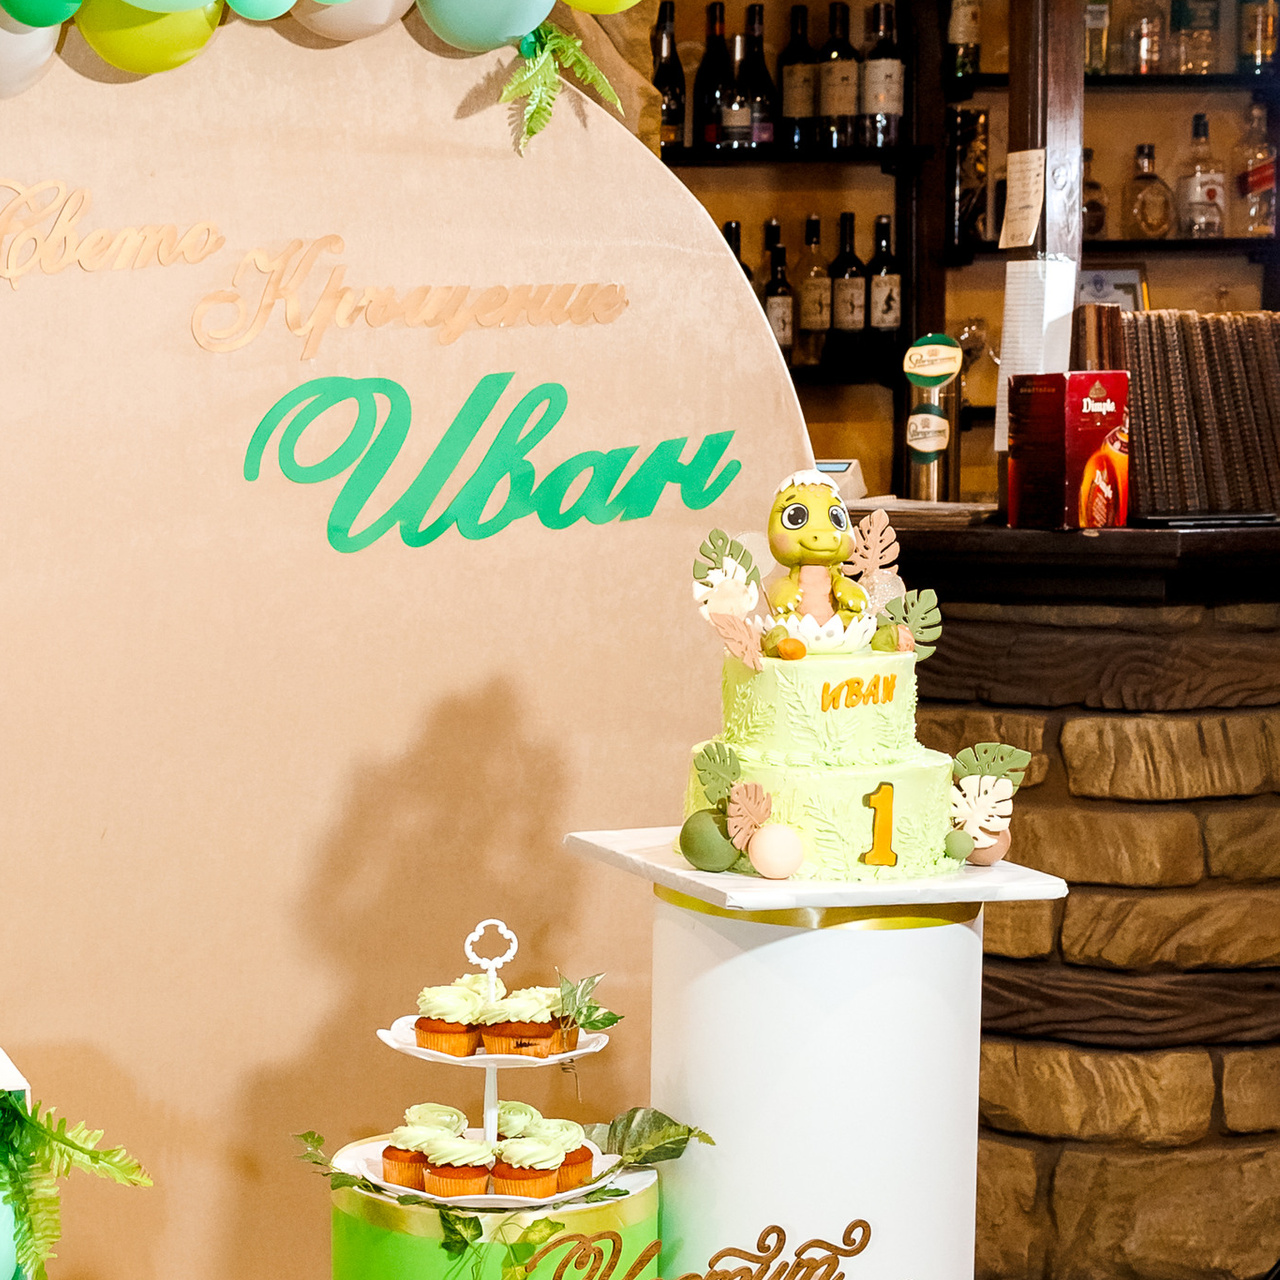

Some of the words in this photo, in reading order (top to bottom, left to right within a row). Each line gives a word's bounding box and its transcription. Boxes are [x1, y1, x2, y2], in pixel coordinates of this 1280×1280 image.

[191, 233, 630, 362] Кръщение
[243, 372, 743, 554] Иван
[820, 673, 898, 712] ИВАН
[862, 782, 899, 867] 1
